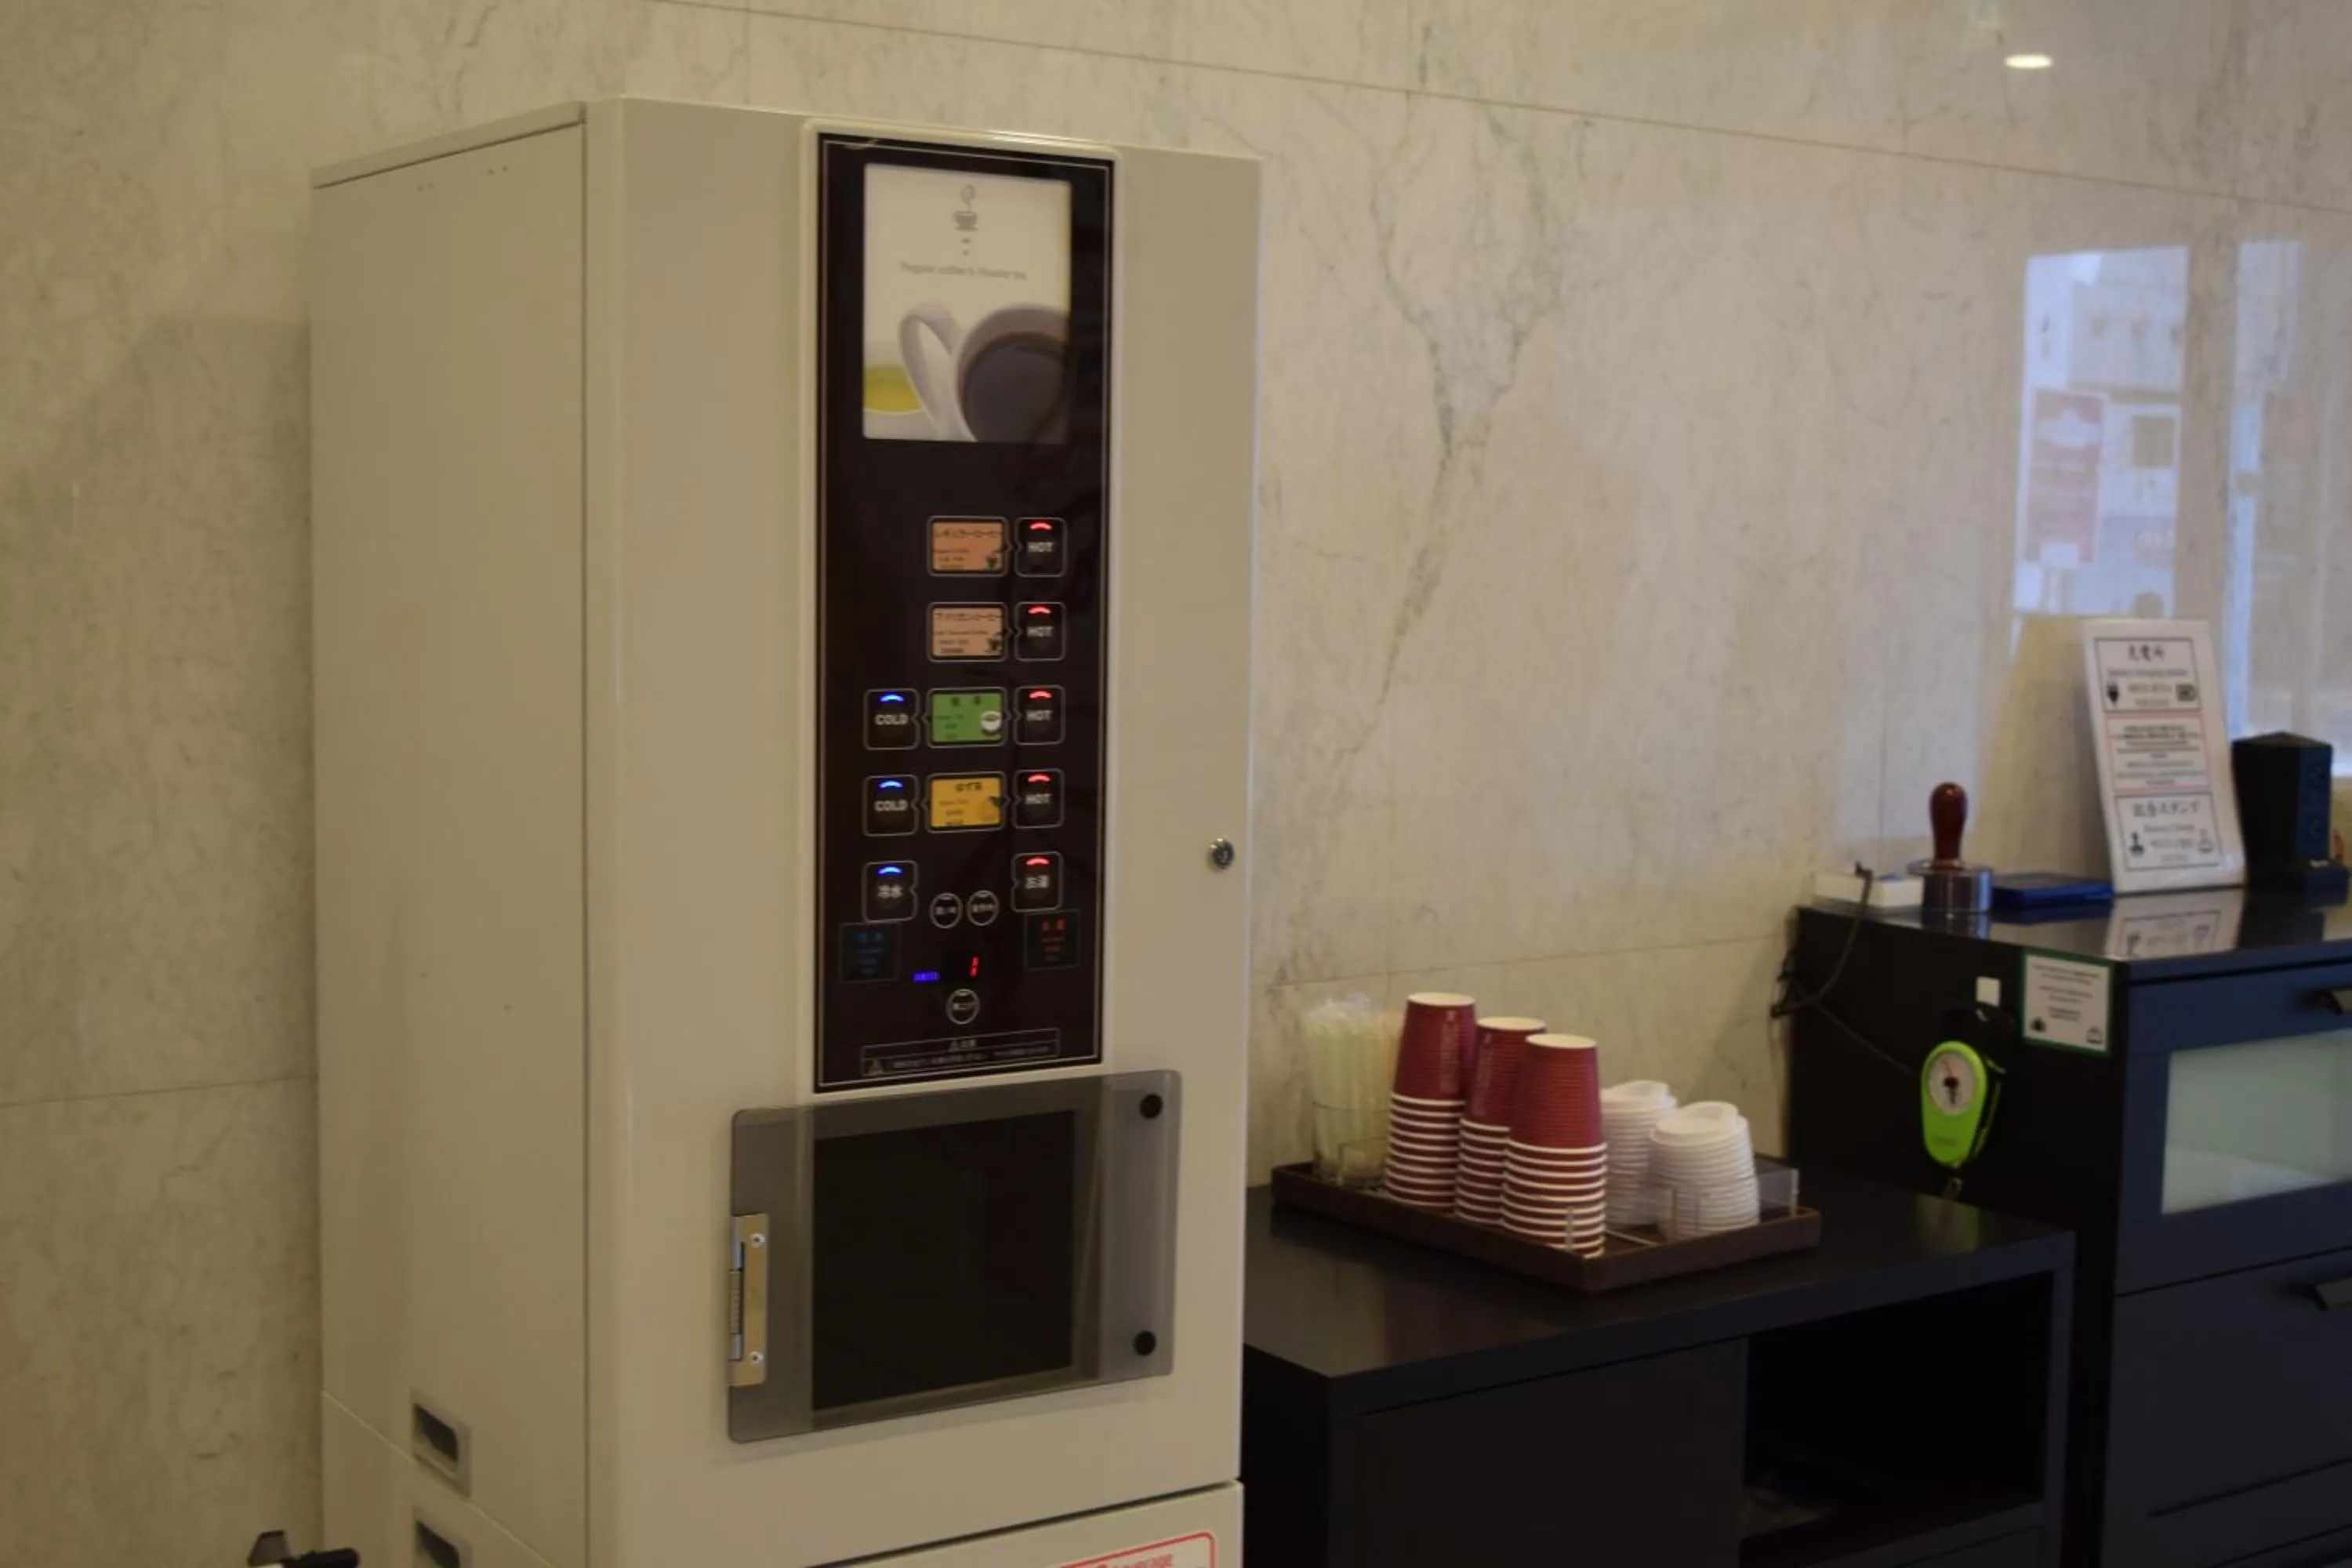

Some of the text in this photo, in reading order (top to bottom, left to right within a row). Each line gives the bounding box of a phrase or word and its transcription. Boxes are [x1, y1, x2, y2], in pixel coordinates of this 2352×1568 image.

[1028, 541, 1053, 553] HOT
[1027, 626, 1053, 637] HOT
[875, 713, 908, 725] COLD
[1026, 709, 1052, 721] HOT
[874, 799, 907, 811] COLD
[1025, 793, 1051, 805] HOT
[969, 956, 979, 977] 1
